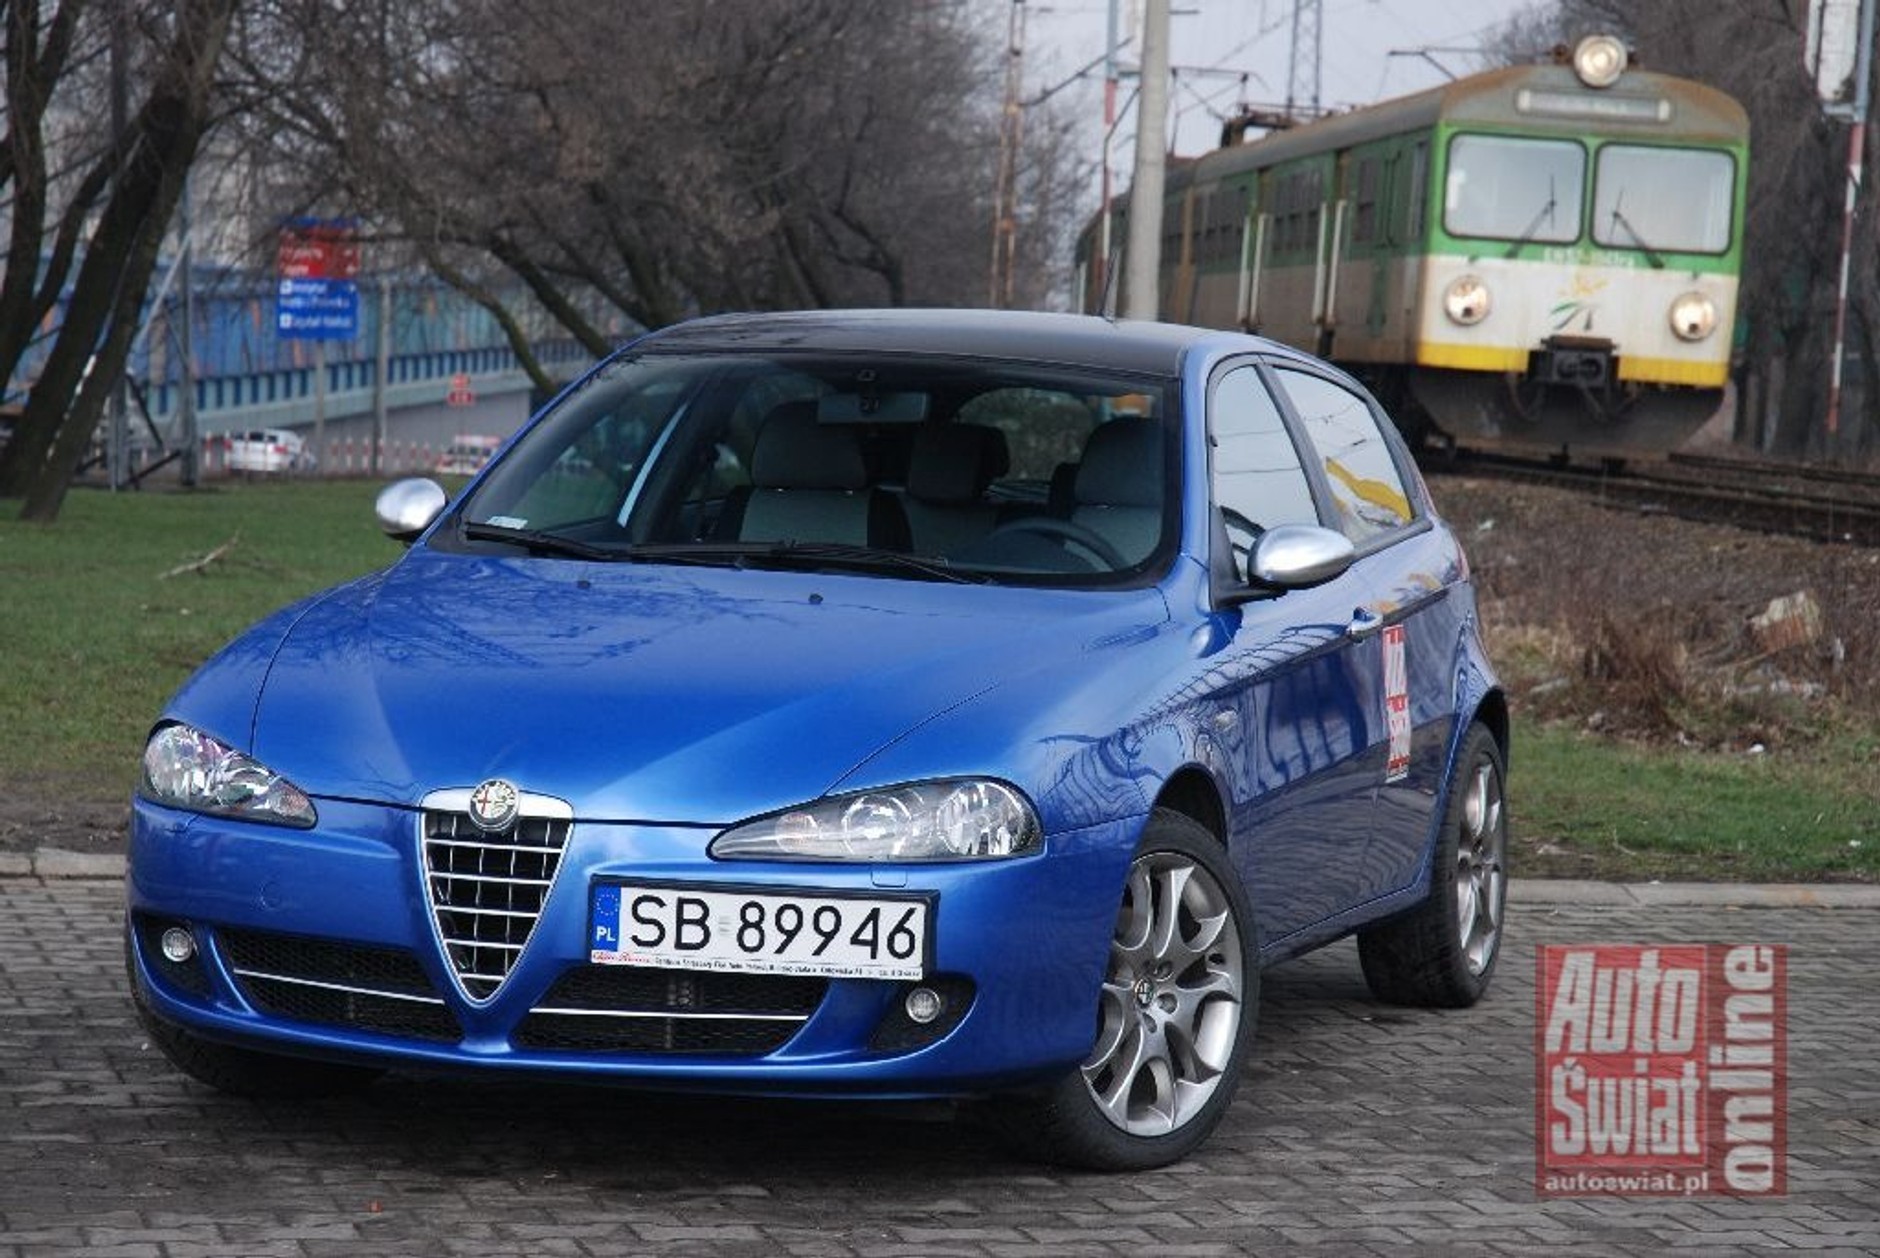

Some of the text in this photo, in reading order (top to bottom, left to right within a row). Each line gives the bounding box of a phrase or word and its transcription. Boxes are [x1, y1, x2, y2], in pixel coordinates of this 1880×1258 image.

[596, 926, 617, 942] PL
[631, 895, 917, 960] SB 89946
